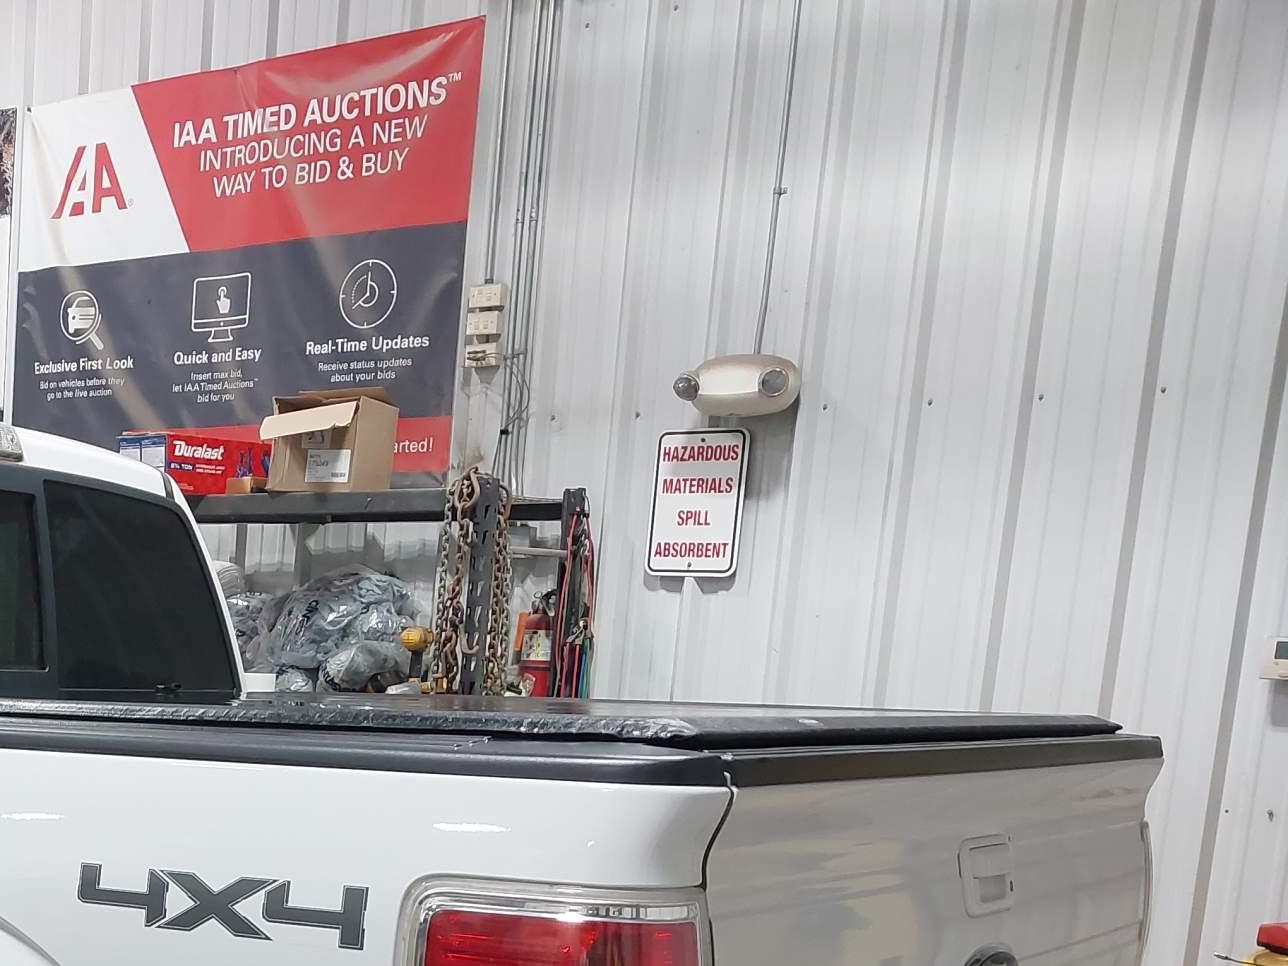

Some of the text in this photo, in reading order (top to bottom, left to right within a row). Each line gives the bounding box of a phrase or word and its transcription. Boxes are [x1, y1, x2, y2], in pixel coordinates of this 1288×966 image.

[173, 118, 216, 147] IAA
[223, 103, 296, 140] TIMED
[200, 114, 428, 171] INTRODUCING A NEW
[213, 147, 409, 197] WAY TO BID & BUY
[306, 335, 430, 355] Real-Time Updates
[34, 355, 133, 374] Exclusive First Look
[173, 347, 262, 365] Quick and Easy
[318, 357, 412, 372] Receive status updates
[39, 377, 125, 390] Bid on vehicles before they
[191, 371, 212, 381] Insert
[330, 370, 396, 383] about your bids
[47, 388, 112, 401] go to the live auction
[172, 383, 182, 393] let
[184, 383, 200, 392] IAA
[200, 381, 222, 391] Timed
[197, 392, 235, 403] bid for you
[172, 440, 225, 461] Duralast
[393, 436, 433, 453] arted!
[662, 444, 740, 463] HAZARDOUS
[662, 477, 734, 494] MATERIALS
[676, 509, 711, 527] SPILL
[654, 542, 729, 559] ABSORBENT
[77, 862, 369, 951] 4X4
